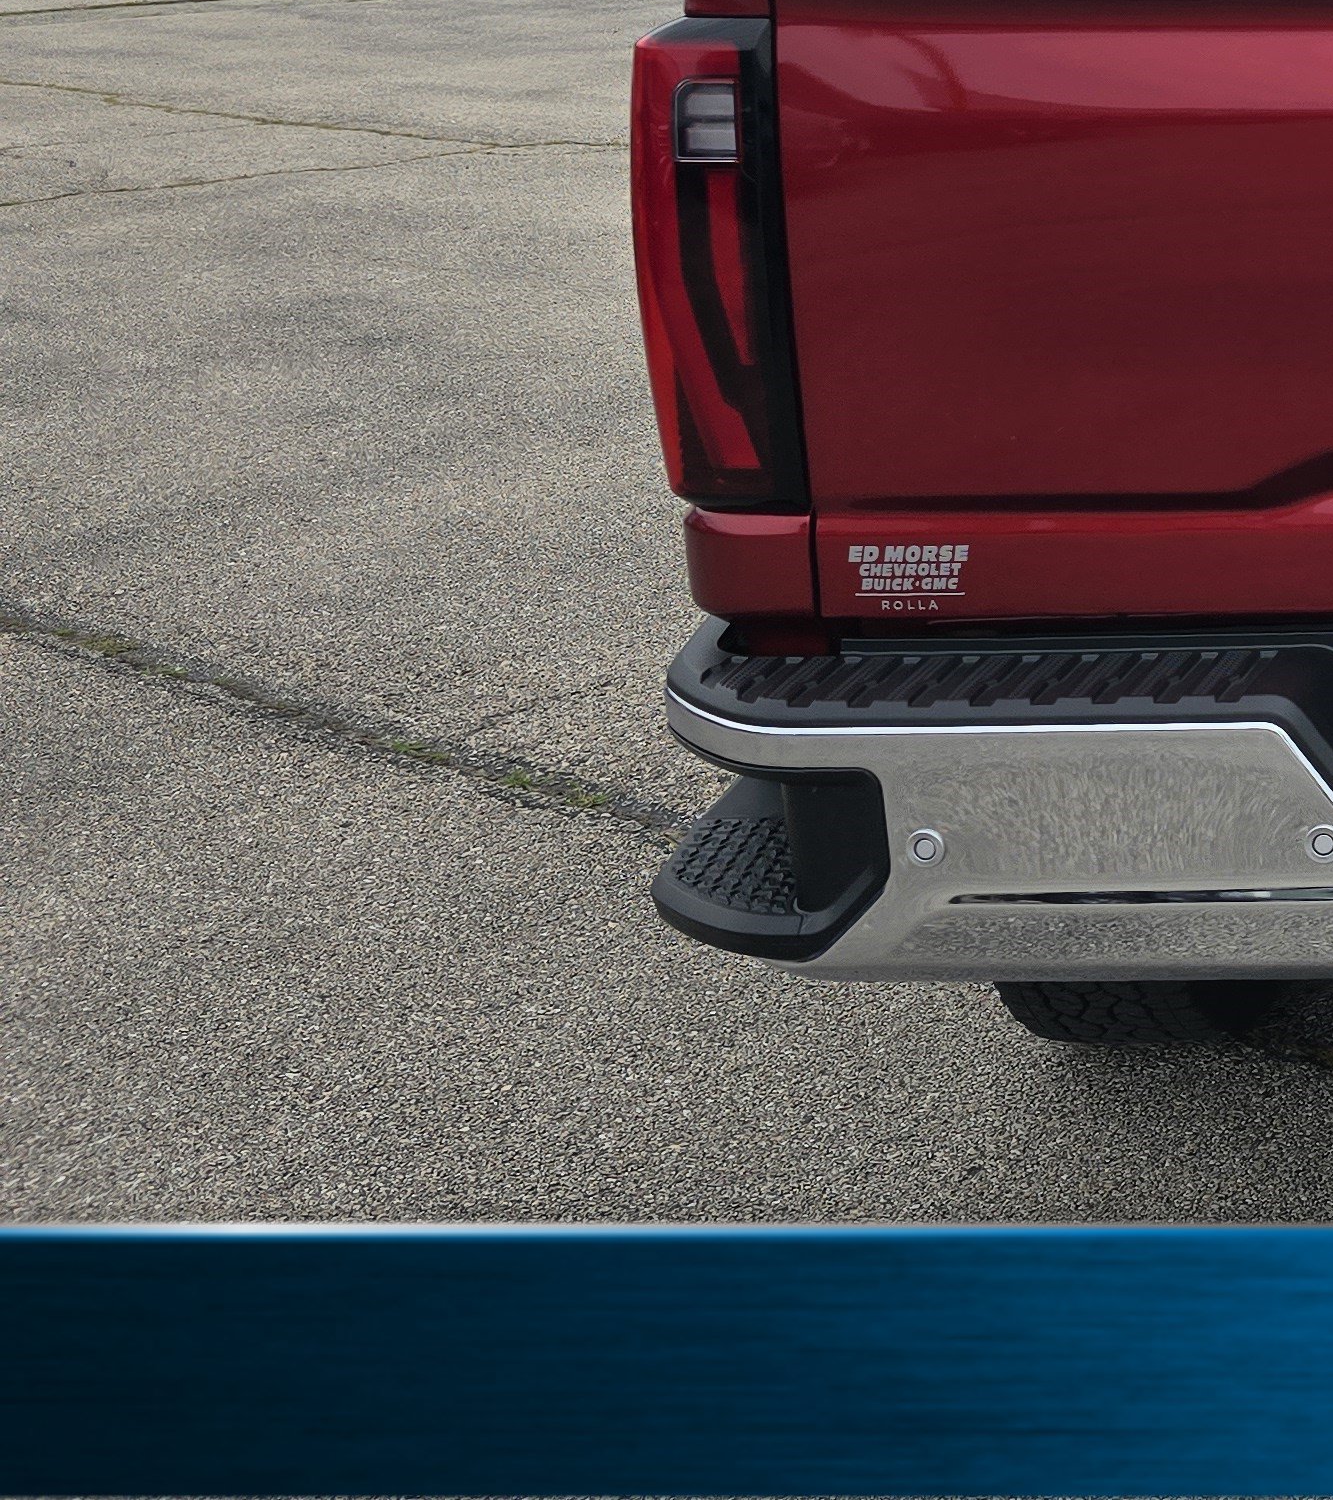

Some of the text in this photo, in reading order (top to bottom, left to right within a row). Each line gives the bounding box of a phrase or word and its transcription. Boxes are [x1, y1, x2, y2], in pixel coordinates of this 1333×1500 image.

[848, 544, 970, 563] ED MORSE
[859, 562, 962, 577] CHEVROLET
[881, 599, 939, 611] ROLLA
